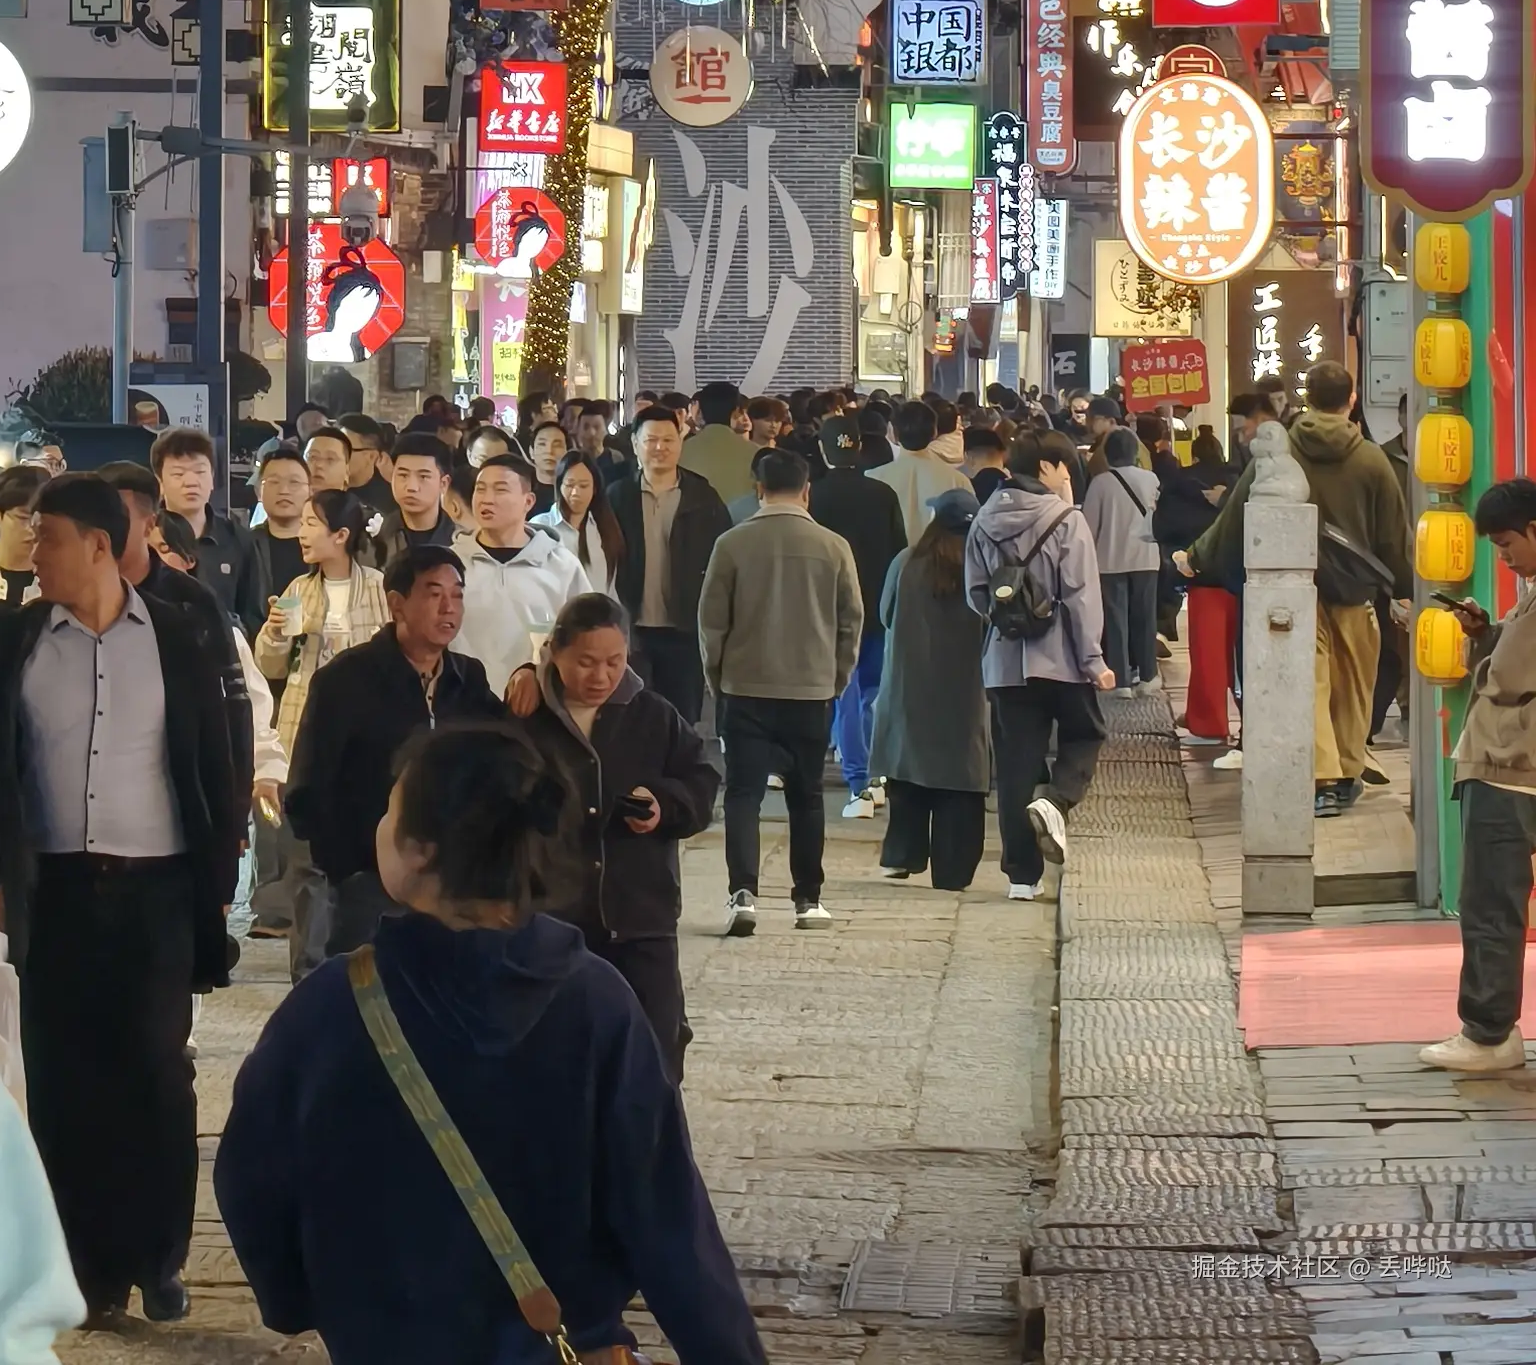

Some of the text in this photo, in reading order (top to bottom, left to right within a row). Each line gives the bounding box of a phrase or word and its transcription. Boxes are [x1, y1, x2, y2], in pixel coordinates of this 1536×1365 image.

[902, 3, 971, 42] 中国
[900, 38, 973, 78] 银都
[1136, 110, 1253, 170] 长沙
[1432, 234, 1449, 281] 王饺儿
[1442, 426, 1458, 474] 王饺儿
